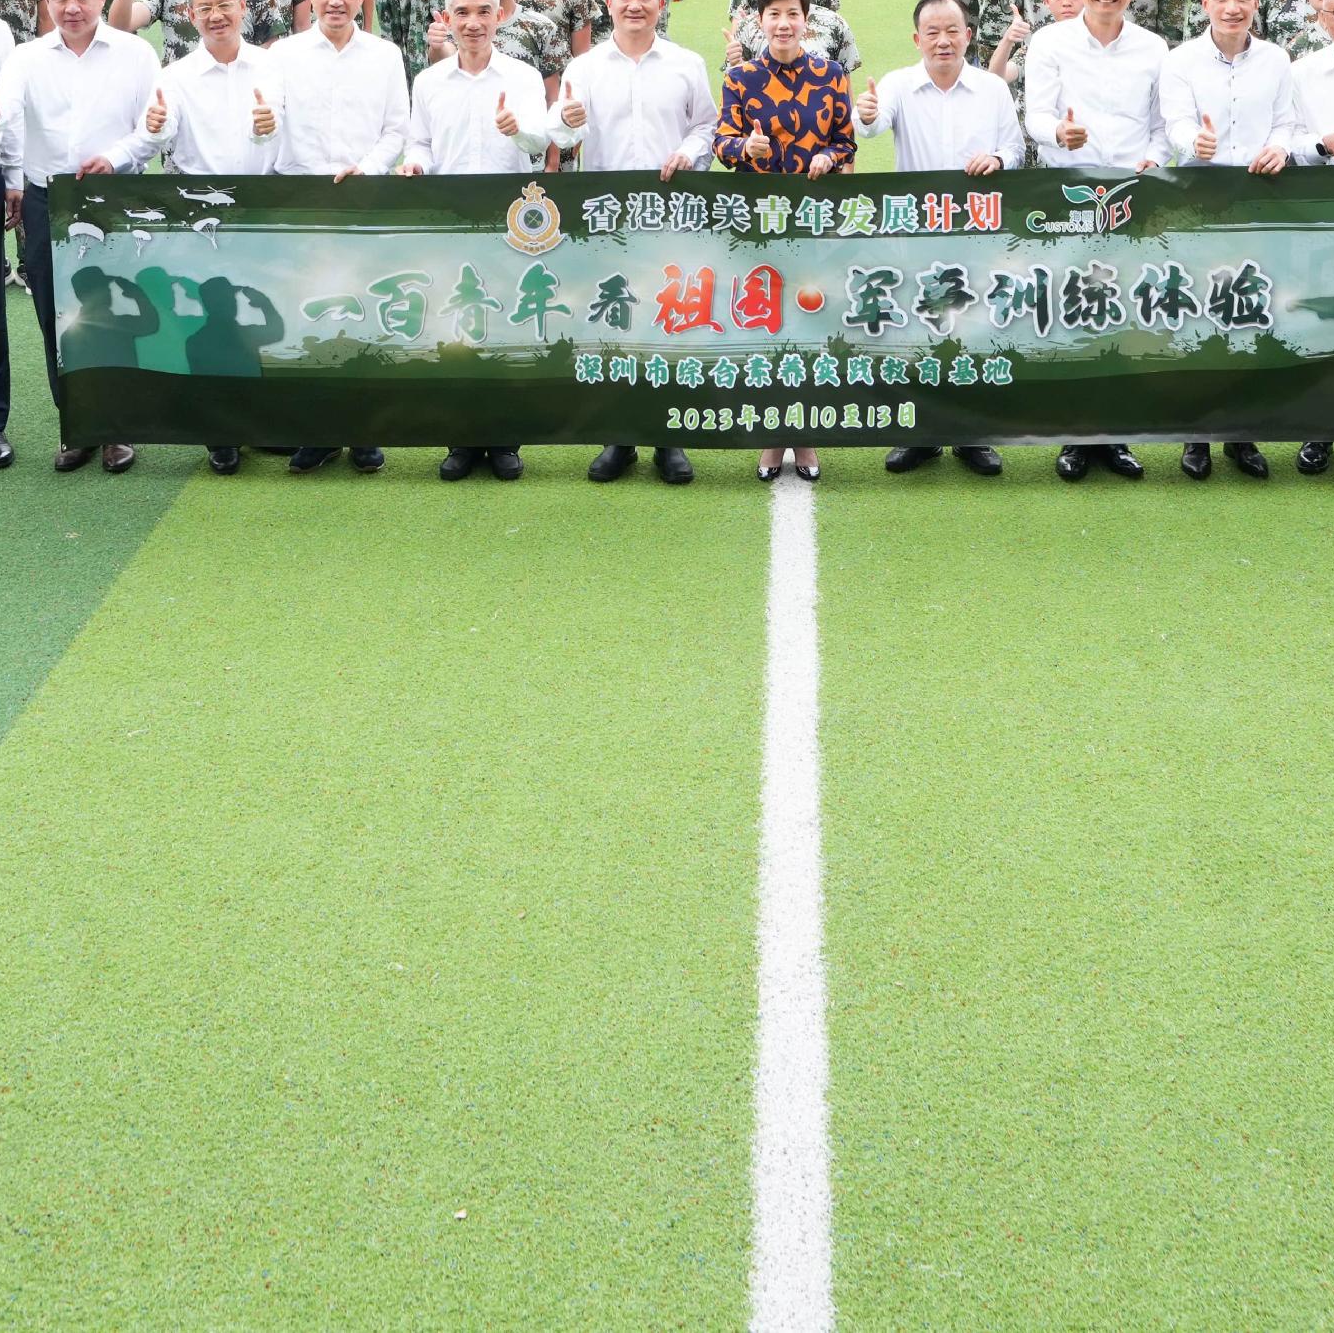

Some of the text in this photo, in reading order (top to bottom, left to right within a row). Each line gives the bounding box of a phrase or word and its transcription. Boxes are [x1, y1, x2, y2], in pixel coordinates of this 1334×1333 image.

[582, 192, 1003, 237] 香港海关青年发展计划
[574, 353, 1014, 389] 深圳市综合素养实践教育基地
[666, 401, 917, 433] 2023年8月10至13日
